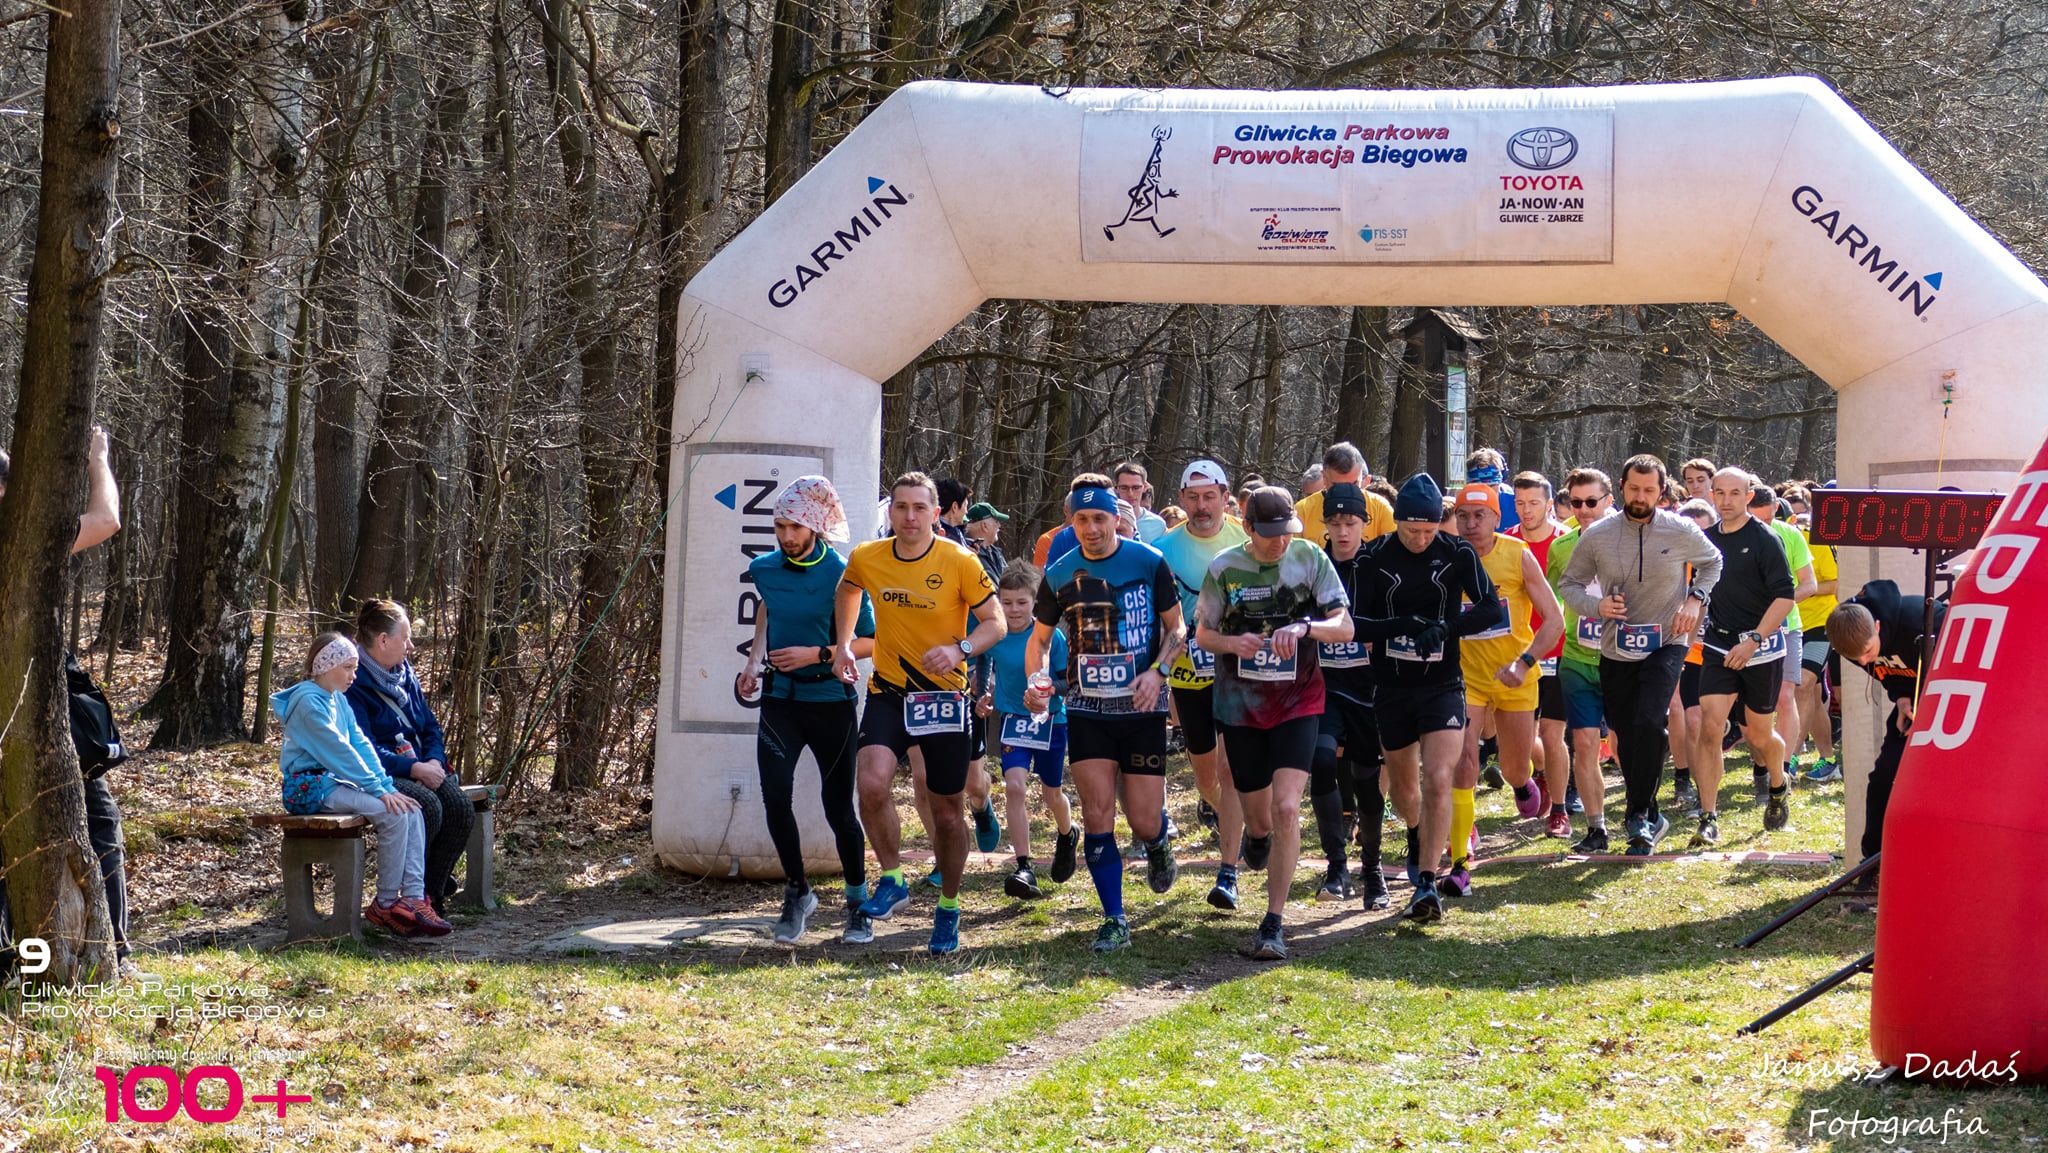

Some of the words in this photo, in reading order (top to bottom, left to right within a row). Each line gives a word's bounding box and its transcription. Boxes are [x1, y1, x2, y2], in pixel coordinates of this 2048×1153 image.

[1234, 125, 1337, 141] Gliwicka
[1344, 124, 1449, 140] Parkowa
[1213, 145, 1354, 169] Prowokacja
[1362, 145, 1468, 168] Biegowa
[1500, 175, 1583, 190] TOYOTA
[1500, 214, 1538, 223] GLIWICE
[1547, 214, 1584, 223] ZABRZE
[1374, 229, 1408, 239] FIS-SST
[768, 184, 908, 308] GARMIN
[1791, 185, 1935, 317] GARMIN
[883, 592, 911, 604] OPEL
[1124, 584, 1146, 609] CIŚ
[1125, 608, 1147, 629] NIE
[1127, 626, 1147, 648] MY
[1625, 635, 1648, 648] 20
[1323, 642, 1359, 655] 329
[1254, 650, 1281, 666] 94
[1086, 665, 1127, 683] 290
[913, 702, 954, 720] 218
[1015, 719, 1039, 735] 84
